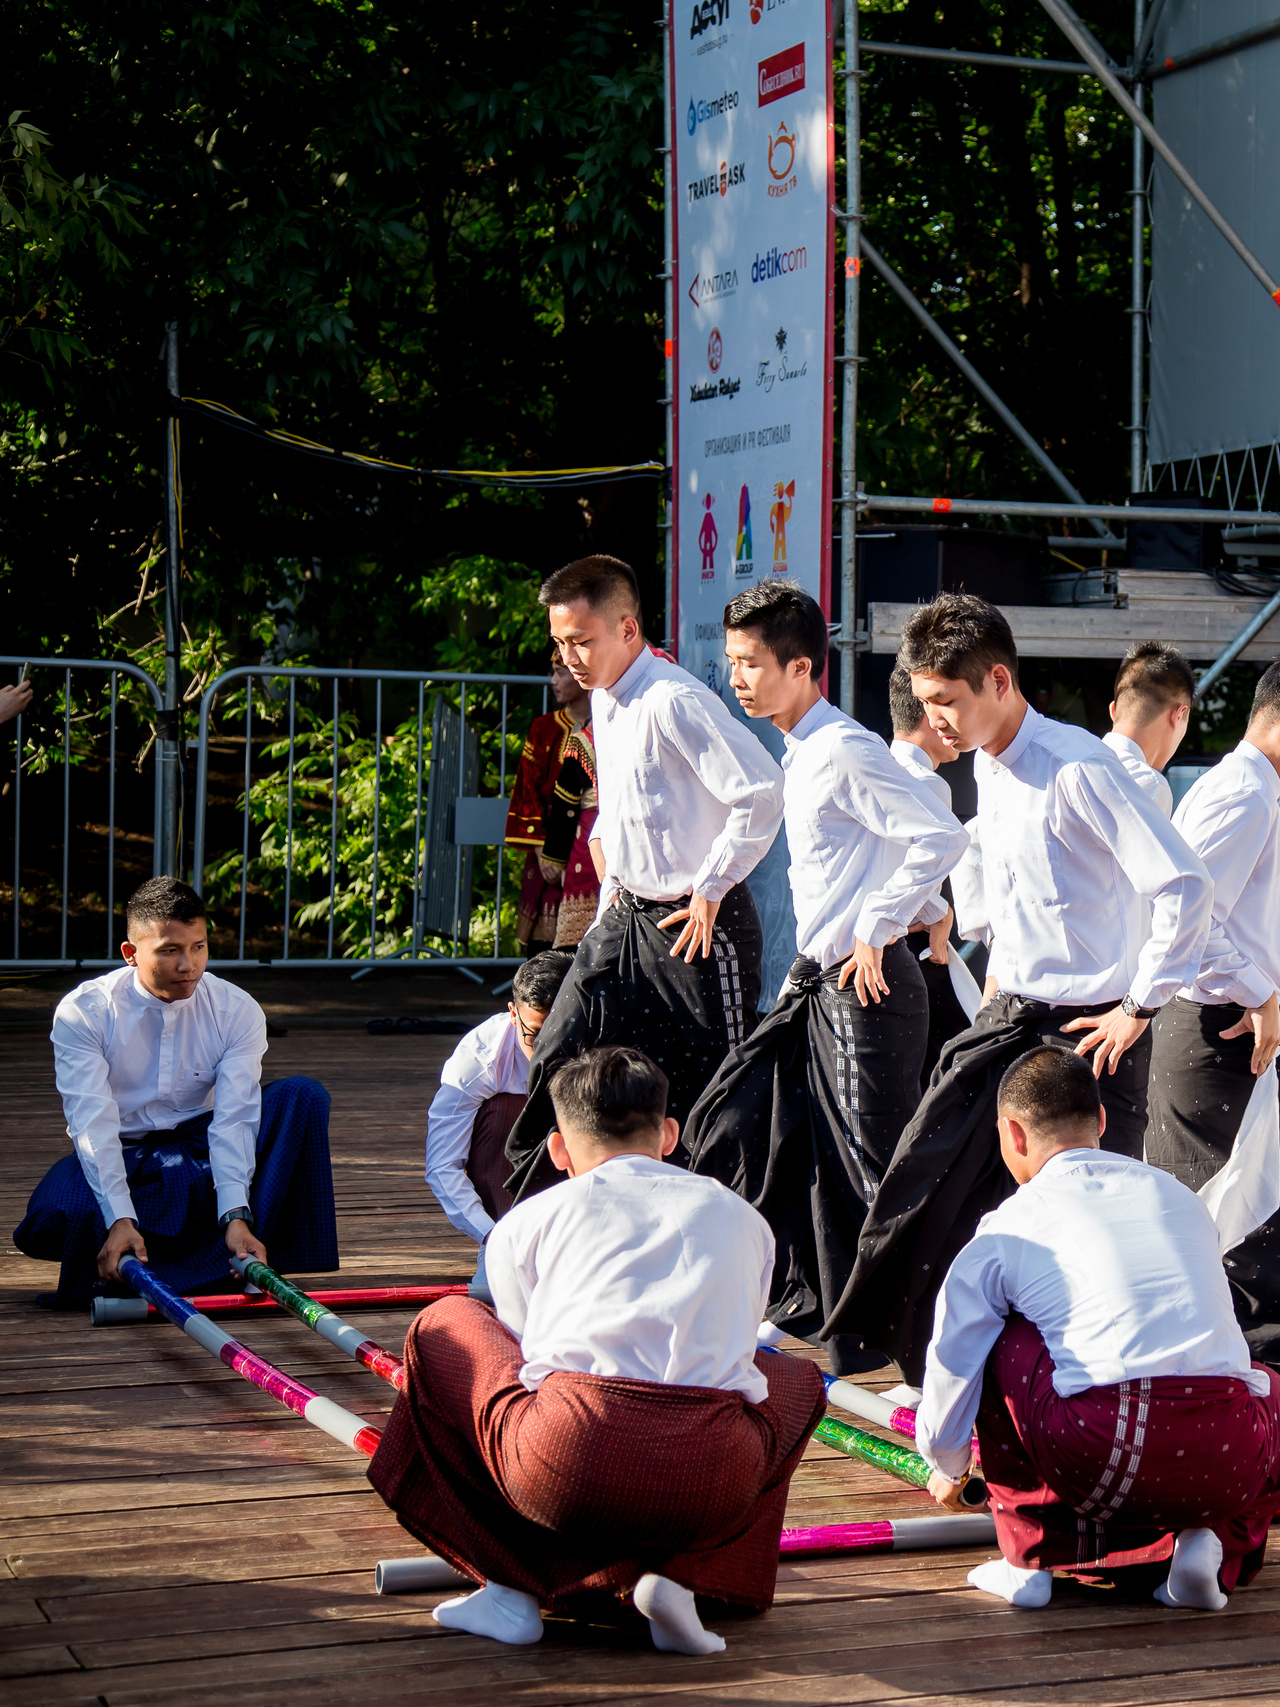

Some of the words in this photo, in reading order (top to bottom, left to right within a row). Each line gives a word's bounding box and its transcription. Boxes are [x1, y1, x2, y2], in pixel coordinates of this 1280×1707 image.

[697, 91, 739, 123] Gismeteo
[751, 247, 807, 283] detikcom
[701, 269, 739, 297] ANTARA
[757, 424, 791, 447] ФЕСТИВАЛЯ
